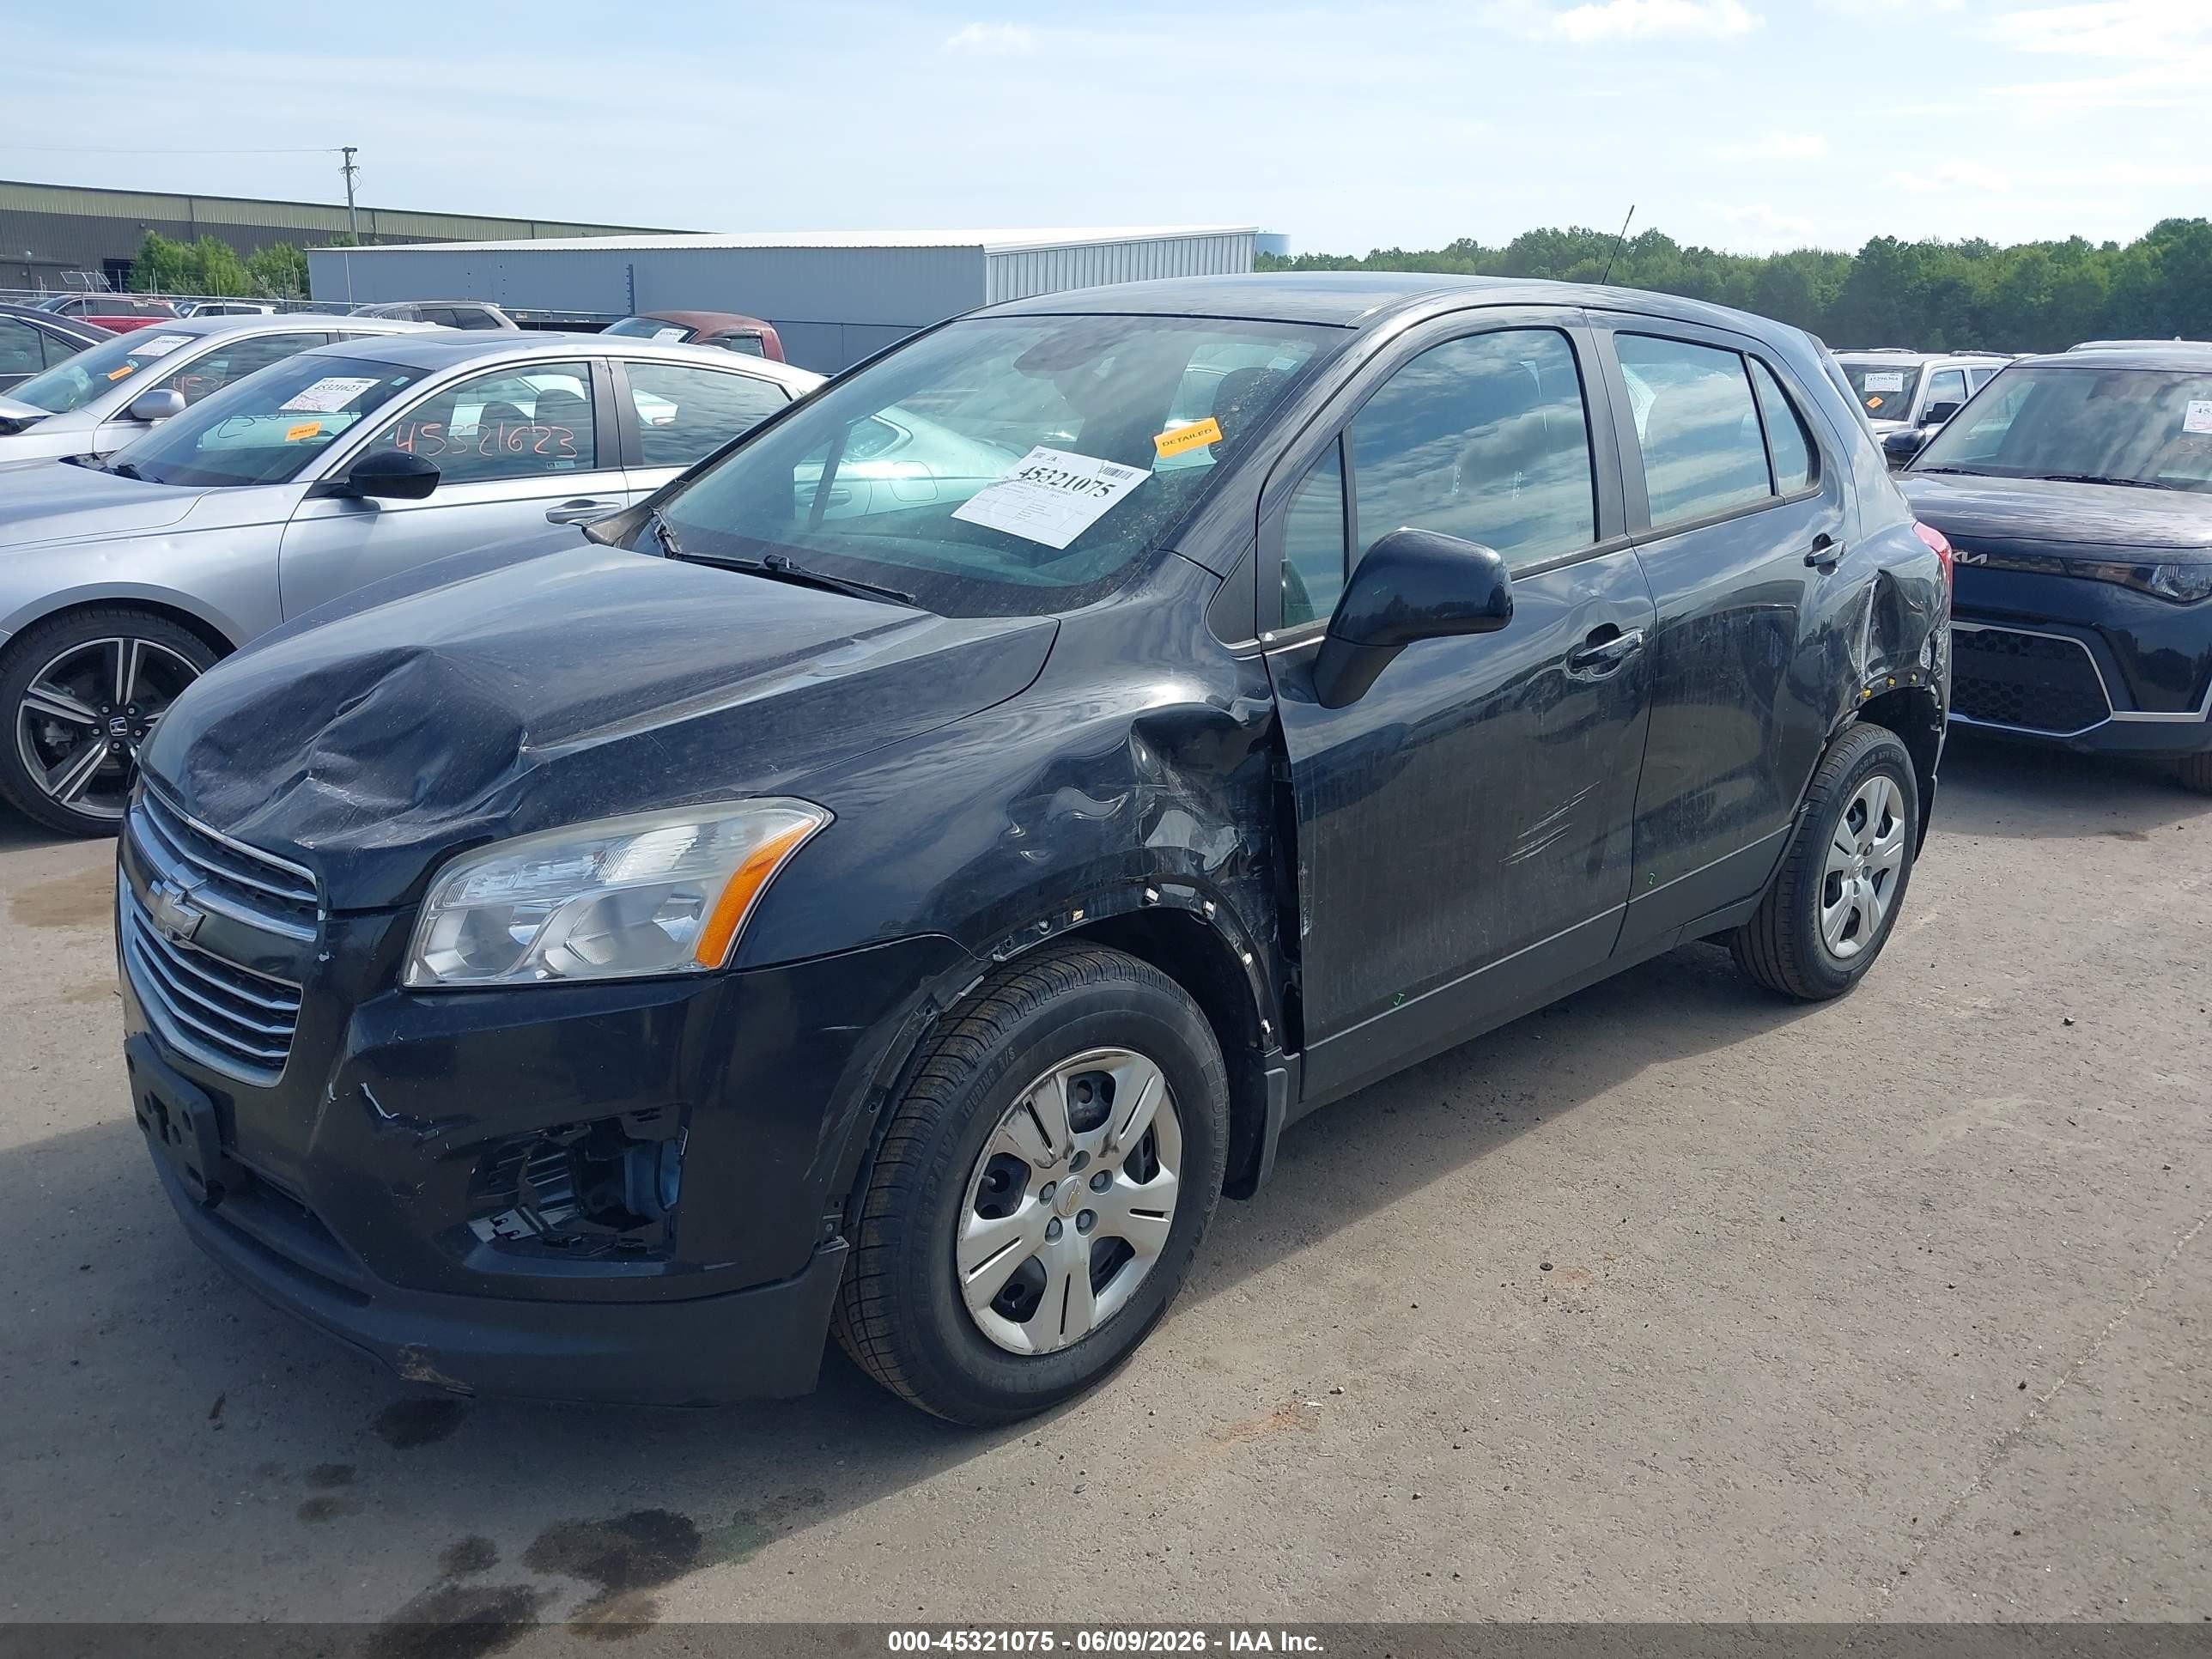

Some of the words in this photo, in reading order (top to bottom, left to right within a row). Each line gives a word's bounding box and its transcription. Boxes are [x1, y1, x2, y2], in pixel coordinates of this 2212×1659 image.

[395, 422, 578, 458] 45321623
[1162, 428, 1212, 447] DETAILED
[1018, 465, 1116, 498] 45321075
